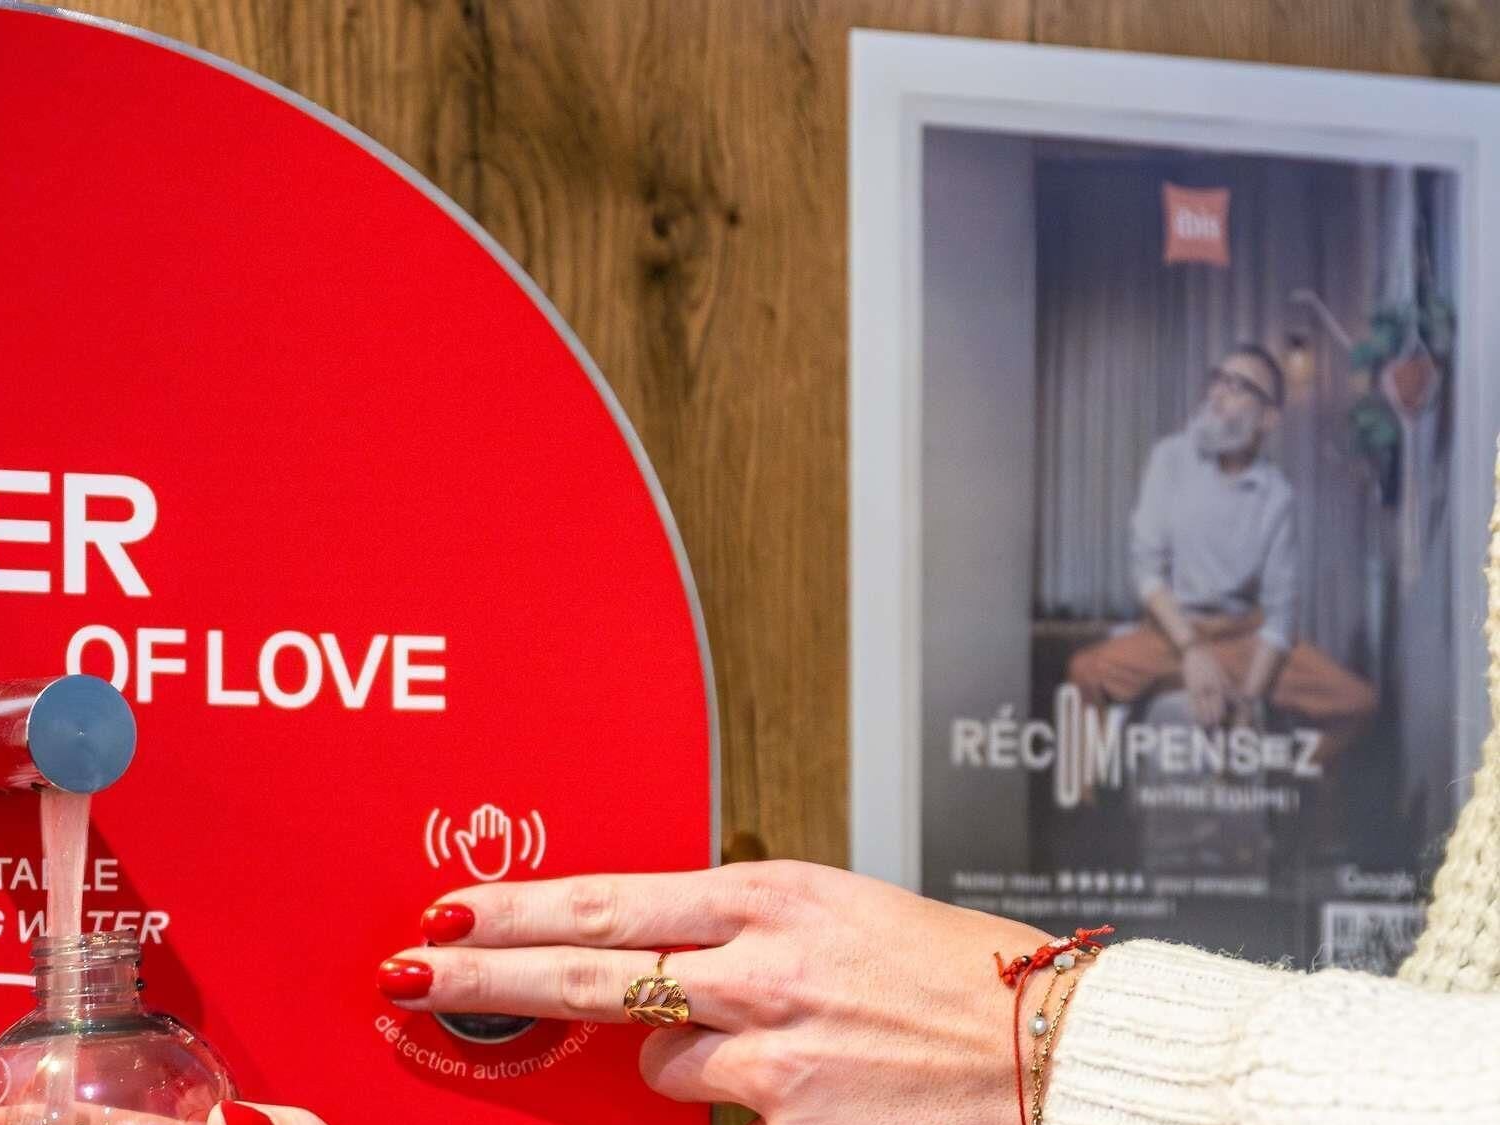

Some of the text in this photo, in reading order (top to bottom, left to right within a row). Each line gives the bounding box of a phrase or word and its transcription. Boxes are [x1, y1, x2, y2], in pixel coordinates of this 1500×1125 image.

[66, 624, 447, 712] OF LOVE
[17, 909, 170, 944] WTER
[374, 1014, 599, 1081] détection automatique
